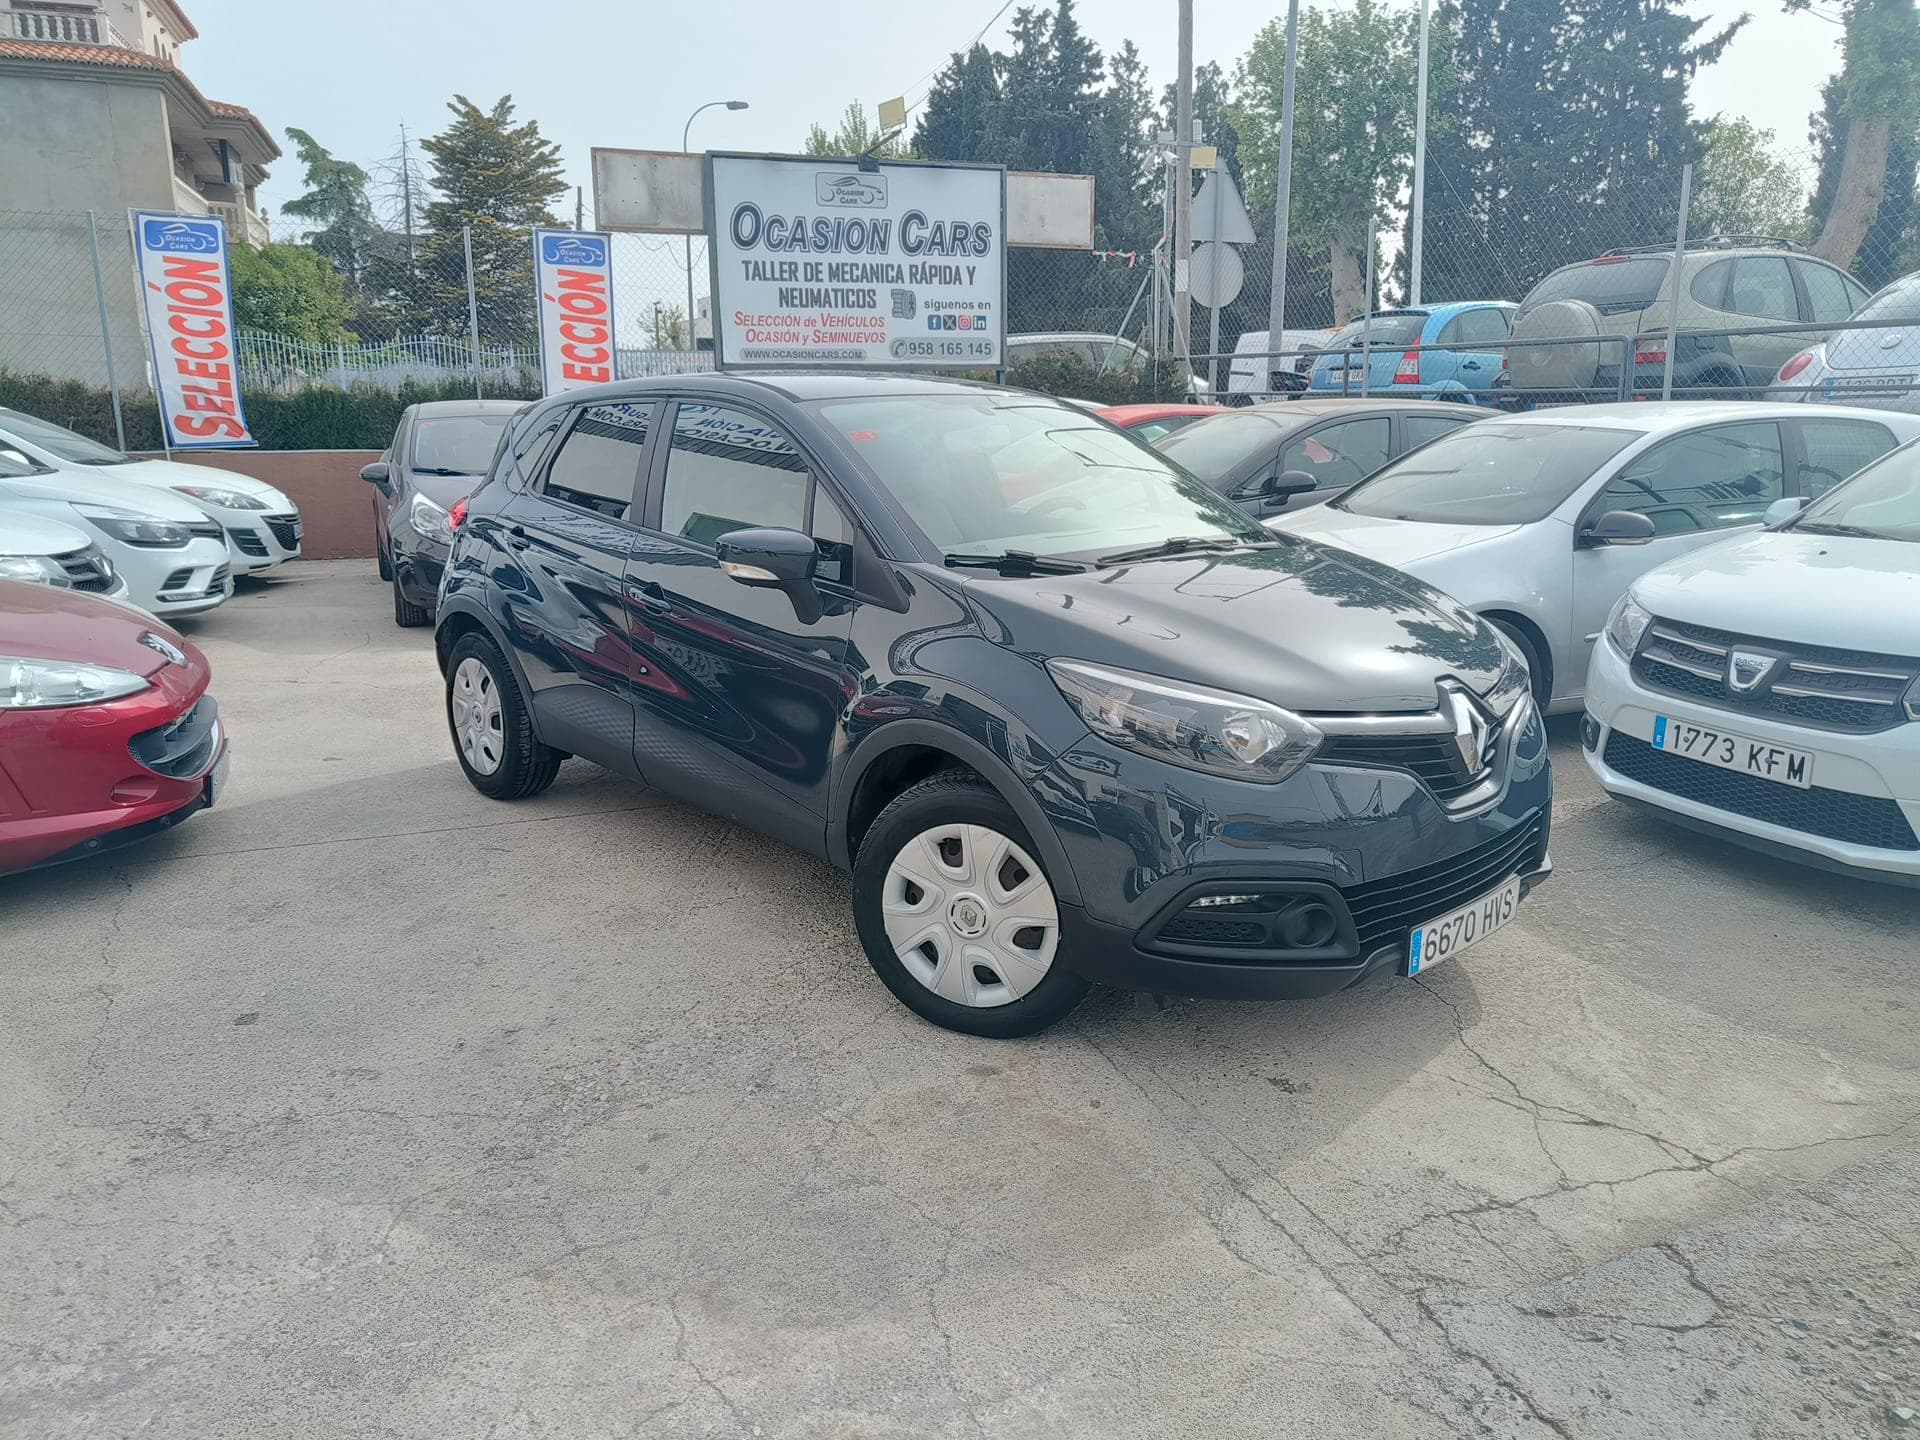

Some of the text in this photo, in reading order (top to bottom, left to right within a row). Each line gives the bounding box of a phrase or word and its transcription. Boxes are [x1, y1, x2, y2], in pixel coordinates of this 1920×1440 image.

[730, 201, 992, 257] OCASION CARS
[741, 260, 976, 286] TALLER DE MECANICA RÁPIDA Y
[779, 287, 876, 309] NEUMATICOS
[978, 302, 991, 310] en
[544, 269, 610, 385] ECCIÓN
[734, 311, 885, 328] SELECCIÓN de VEHÍCULOS
[148, 256, 245, 438] SELECCIÓN
[745, 329, 886, 345] OCASIÓN y SEMINUEVOS
[744, 350, 862, 360] WWW.OCASIONCARS.COM
[909, 342, 992, 355] 958 165 145
[1736, 657, 1763, 668] DACIA
[1673, 724, 1735, 763] 1773
[1747, 744, 1806, 783] KFM
[1424, 910, 1476, 961] 6670
[1482, 888, 1512, 934] HVS
